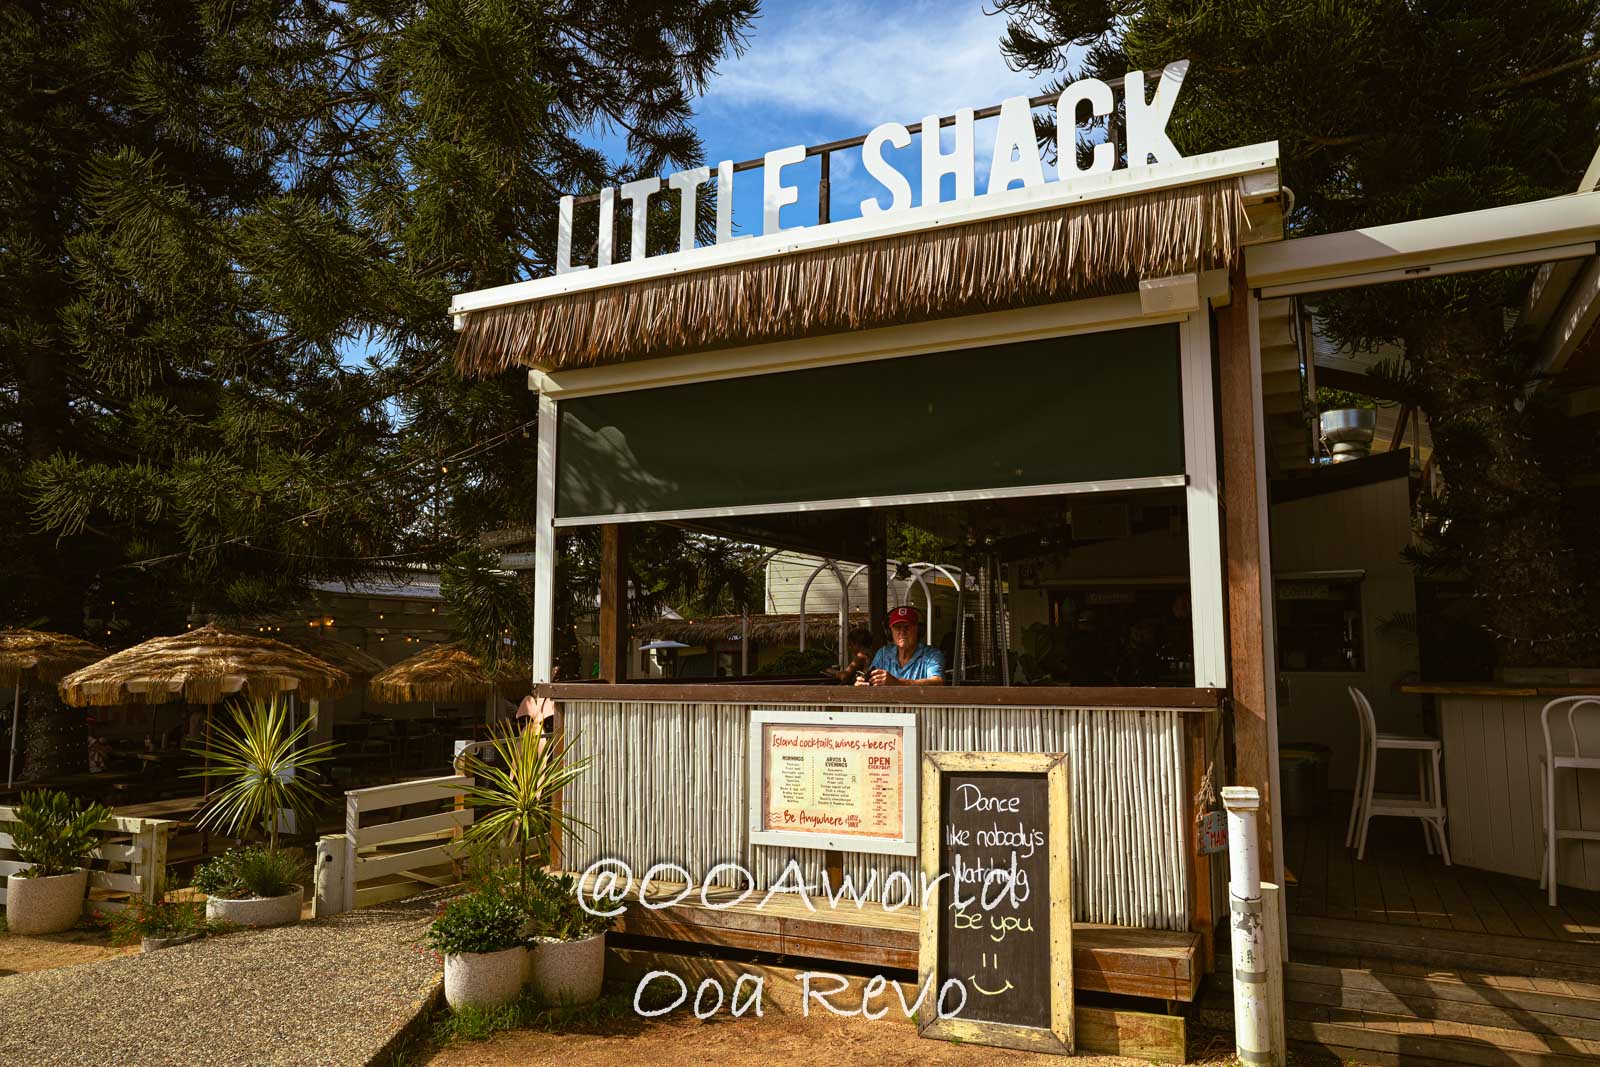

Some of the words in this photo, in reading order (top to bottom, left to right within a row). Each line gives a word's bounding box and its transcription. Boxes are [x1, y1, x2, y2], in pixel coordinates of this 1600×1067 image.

[555, 144, 808, 276] LITTLE
[860, 59, 1192, 218] SHACK
[772, 734, 799, 748] Island
[835, 739, 860, 750] wines
[867, 739, 896, 751] beers!
[868, 756, 891, 765] OPEN
[956, 783, 1020, 812] Dance
[783, 809, 797, 824] Be
[799, 810, 844, 828] Anywhere
[976, 822, 1044, 858] nobody's
[949, 904, 983, 930] Be
[989, 916, 1035, 943] you
